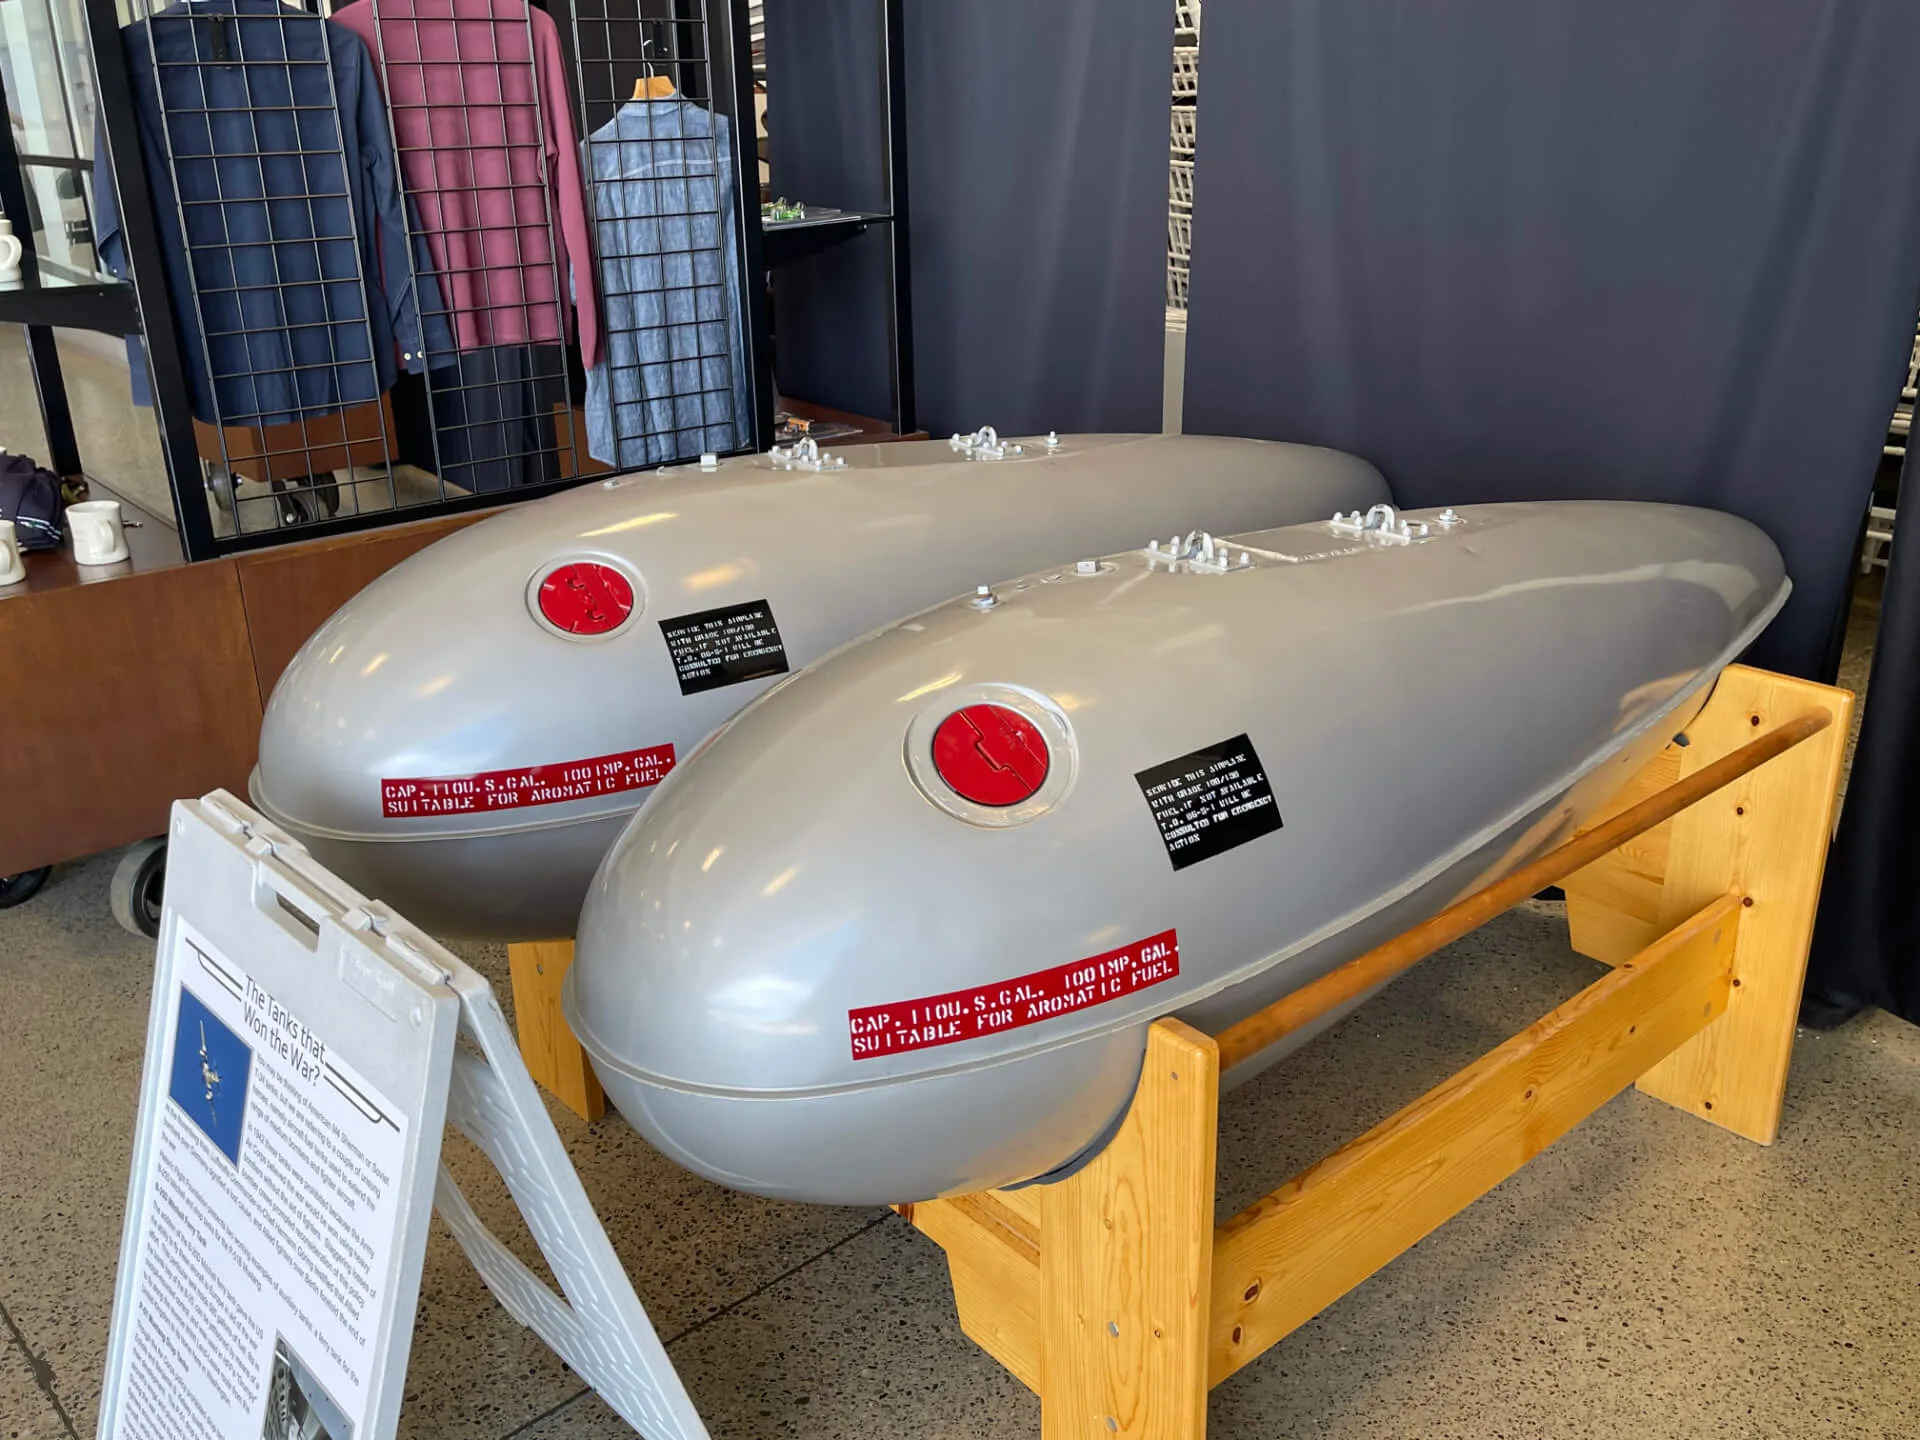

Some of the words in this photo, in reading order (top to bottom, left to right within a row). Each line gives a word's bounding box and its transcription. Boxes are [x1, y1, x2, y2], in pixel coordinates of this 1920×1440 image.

[705, 620, 723, 629] THIS
[728, 611, 764, 625] AIRPLANE
[671, 638, 691, 647] WITH
[715, 638, 731, 647] NOT
[735, 628, 776, 641] AVAILABLE
[733, 641, 751, 651] WILL
[754, 638, 764, 647] BE
[726, 653, 740, 662] FOR
[681, 668, 711, 680] ACTION
[1146, 778, 1182, 797] SERVICE
[1185, 769, 1205, 782] THIS
[1210, 753, 1246, 773] AIRPLANE
[388, 798, 474, 814] SUITABLE
[487, 792, 519, 806] FOR
[531, 778, 615, 801] AROMATIC
[1151, 796, 1174, 808] WITH
[1177, 785, 1204, 799] GRADE
[1200, 790, 1217, 803] NOT
[1221, 773, 1264, 796] AVAILABLE
[1219, 796, 1239, 808] WILL
[1242, 789, 1252, 799] BE
[1165, 818, 1210, 841] CONSULTED
[1213, 810, 1229, 824] FOR
[1232, 795, 1273, 817] EMERGENCY
[1169, 834, 1200, 851] ACTION
[853, 1023, 962, 1054] SUITABLE
[977, 1009, 1013, 1031] FOR
[1027, 977, 1121, 1019] AROMATIC
[1132, 960, 1174, 986] FUEL
[245, 974, 266, 1010] The
[267, 995, 299, 1039] Tanks
[300, 1026, 326, 1064] that
[243, 1001, 268, 1041] Won
[270, 1027, 289, 1060] the
[289, 1042, 321, 1087] War?
